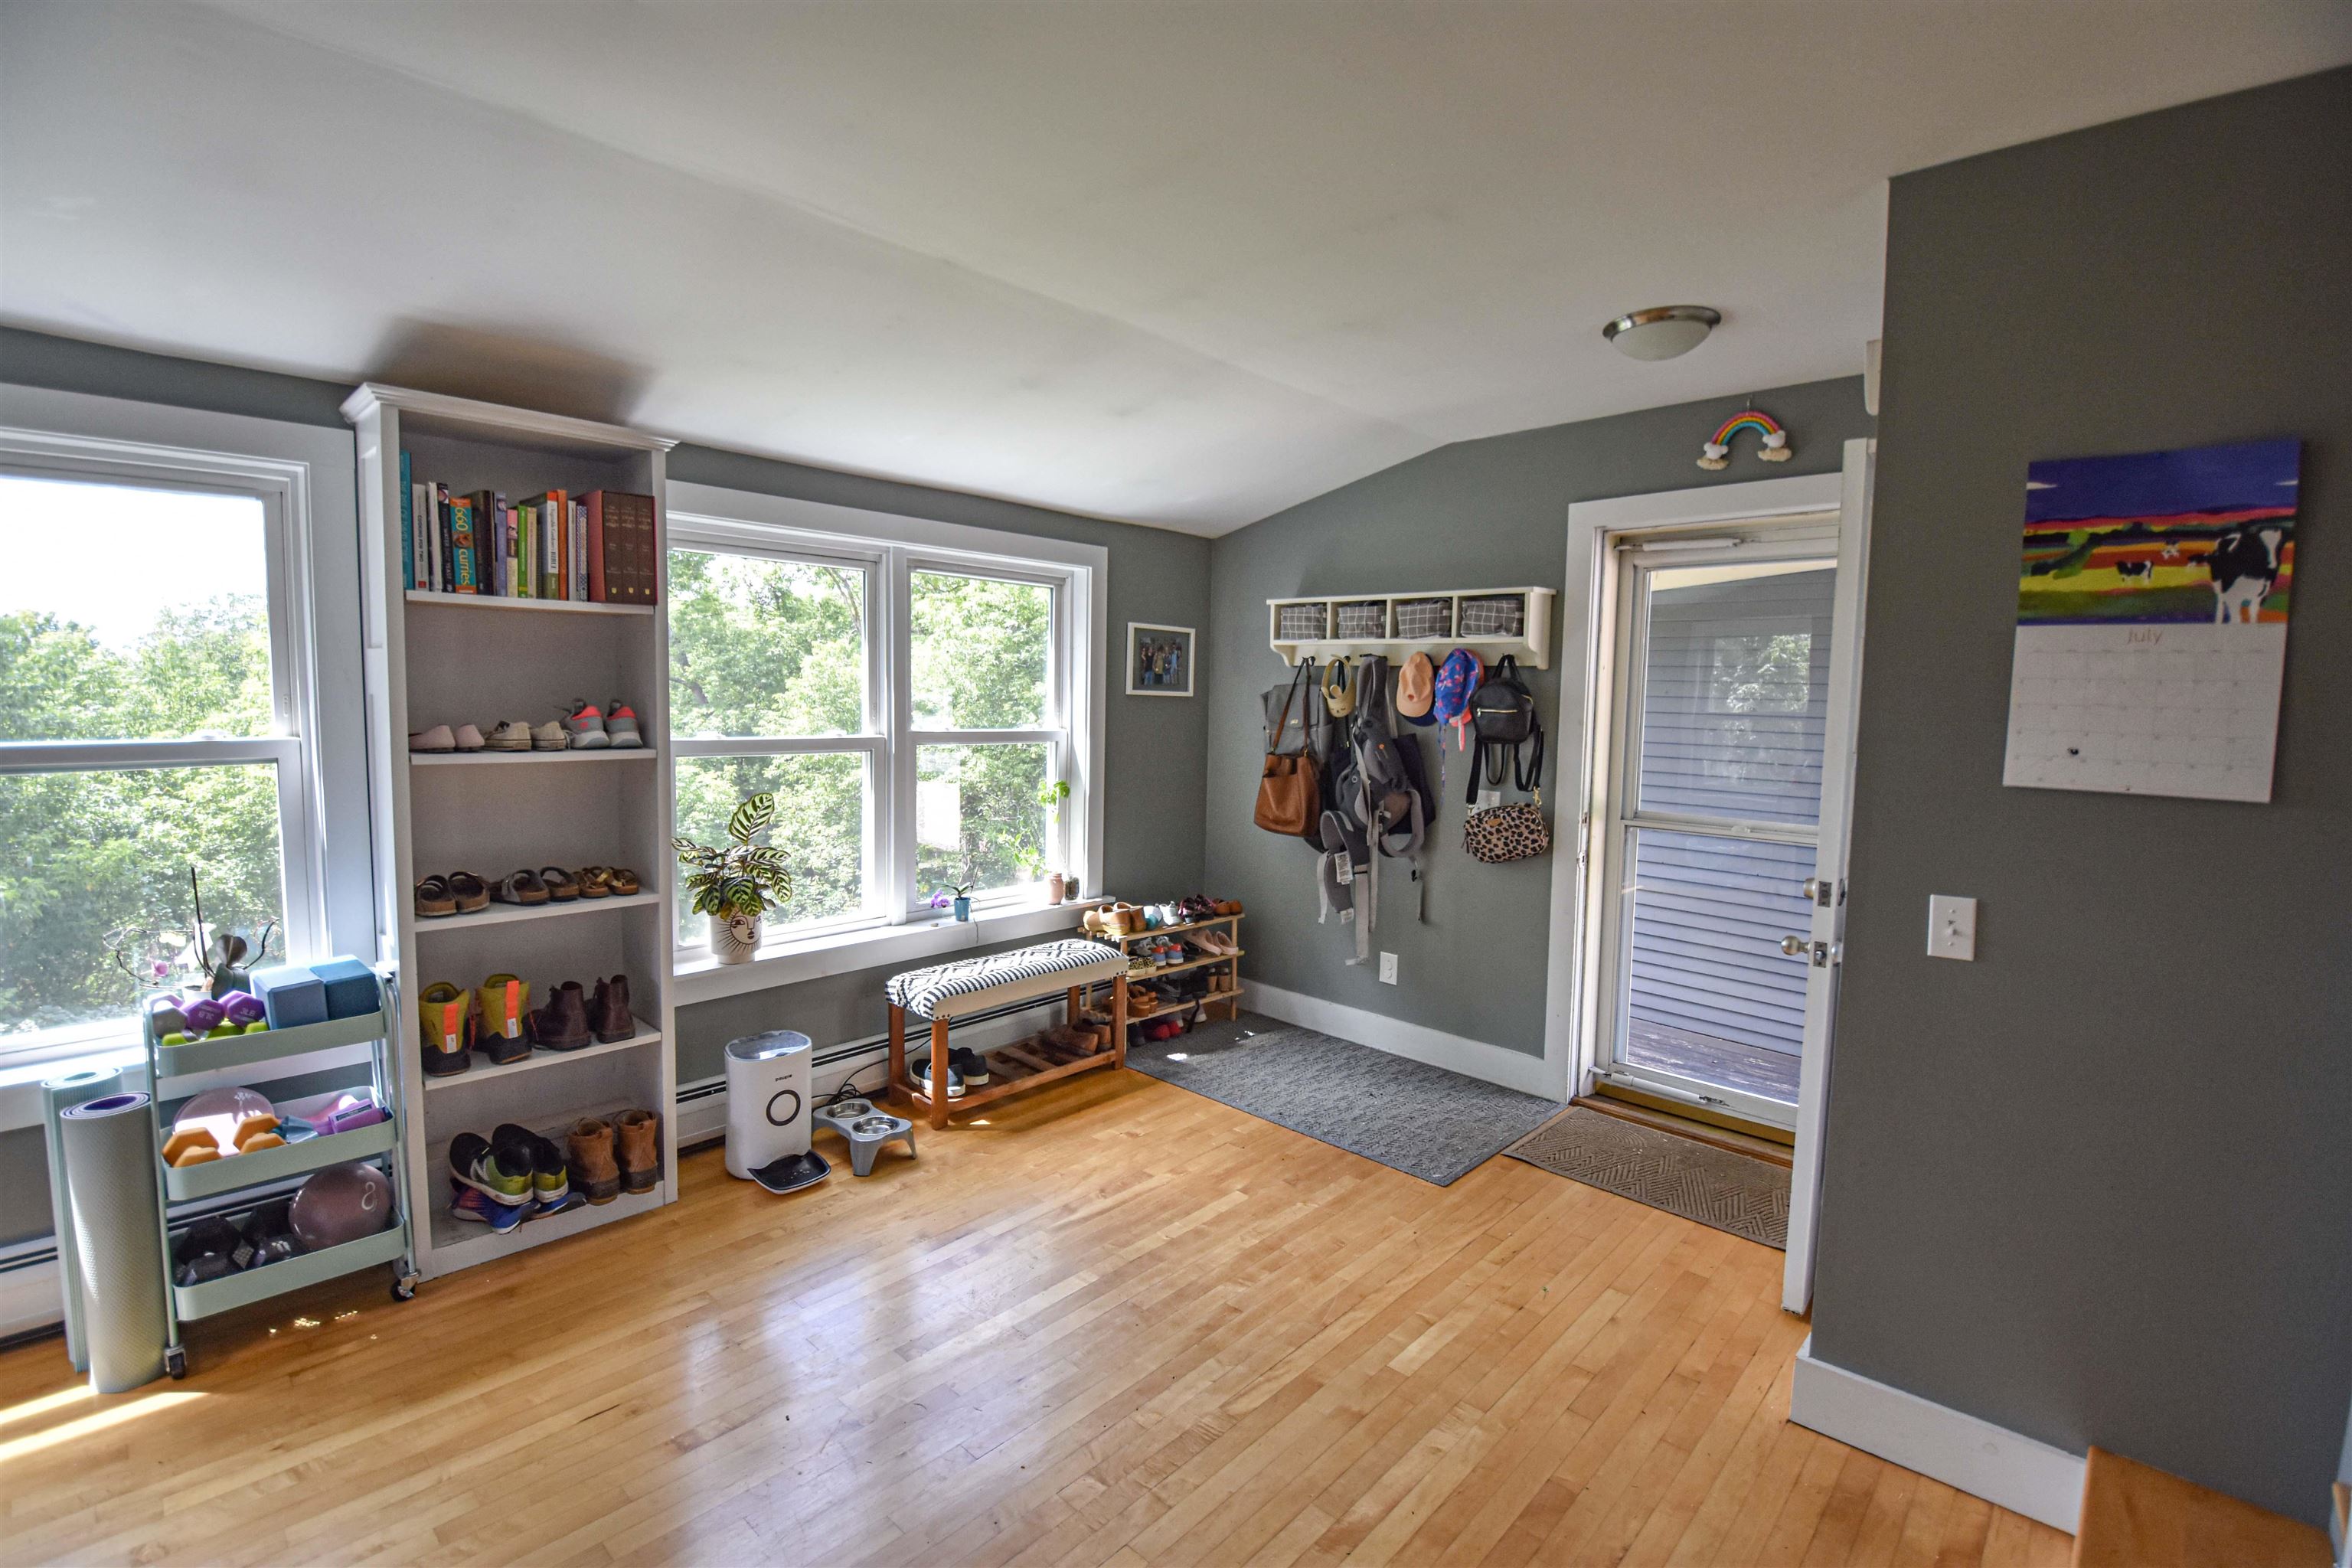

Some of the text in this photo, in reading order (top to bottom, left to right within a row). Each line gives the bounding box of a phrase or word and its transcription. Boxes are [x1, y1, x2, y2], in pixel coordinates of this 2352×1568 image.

[456, 508, 472, 586] 660 curries
[2127, 628, 2164, 645] July
